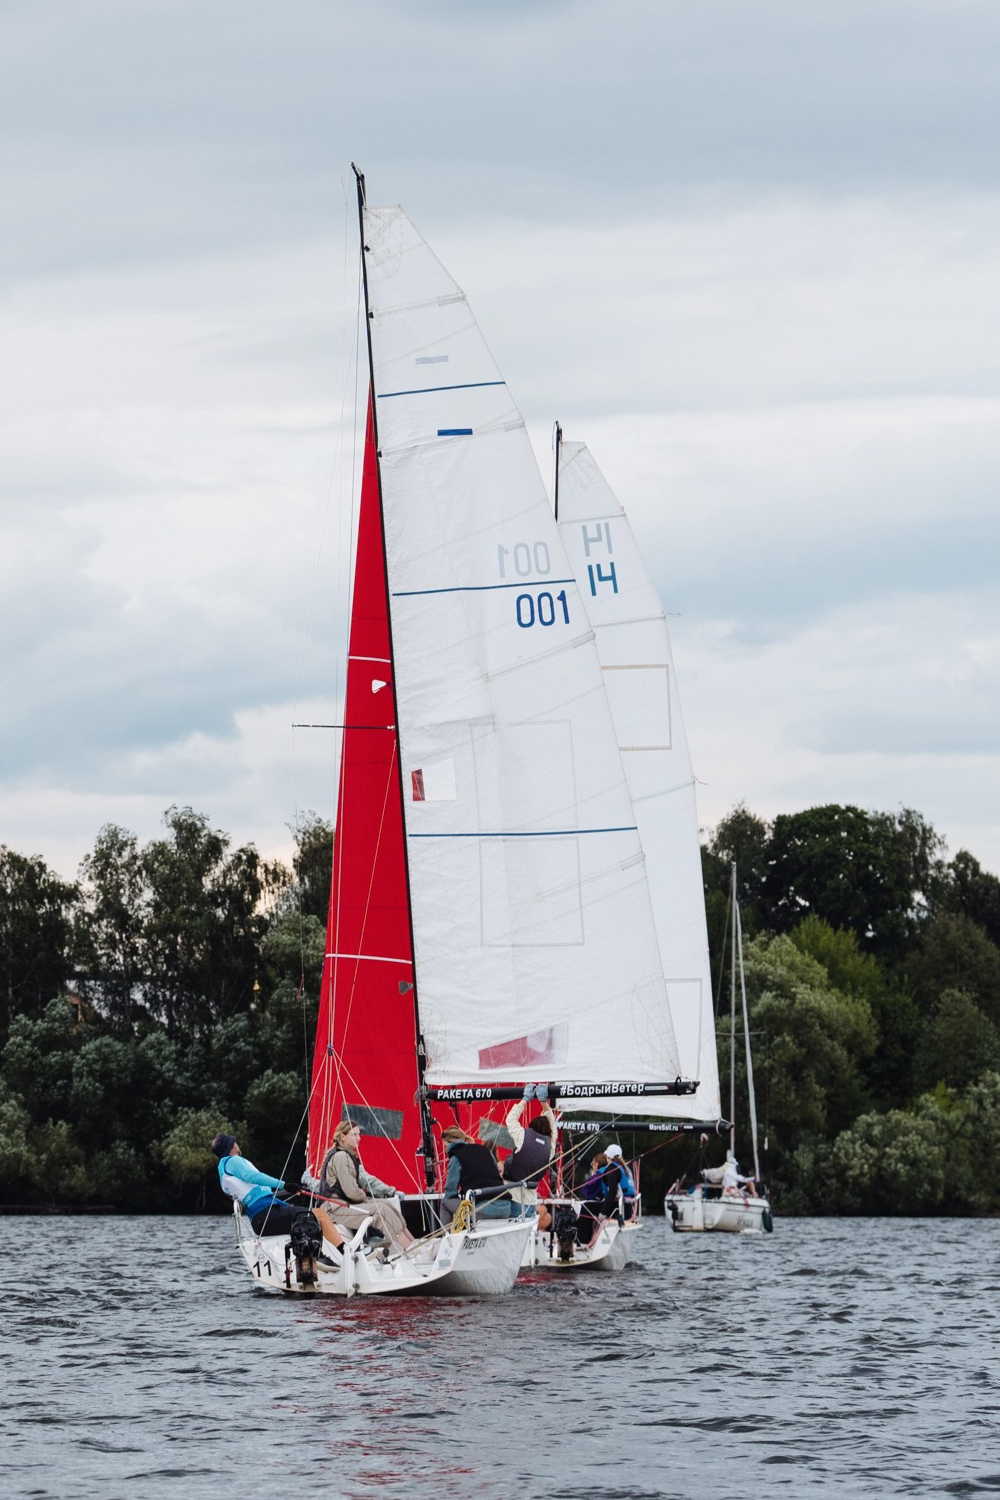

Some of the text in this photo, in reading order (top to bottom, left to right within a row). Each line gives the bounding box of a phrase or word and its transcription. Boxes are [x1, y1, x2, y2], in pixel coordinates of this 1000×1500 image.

[587, 561, 618, 596] 14
[516, 590, 570, 628] 001
[437, 1088, 492, 1099] РАКЕТА 670
[560, 1083, 645, 1097] #БодрыйВетер
[587, 1123, 600, 1131] 670
[253, 1260, 272, 1278] 11
